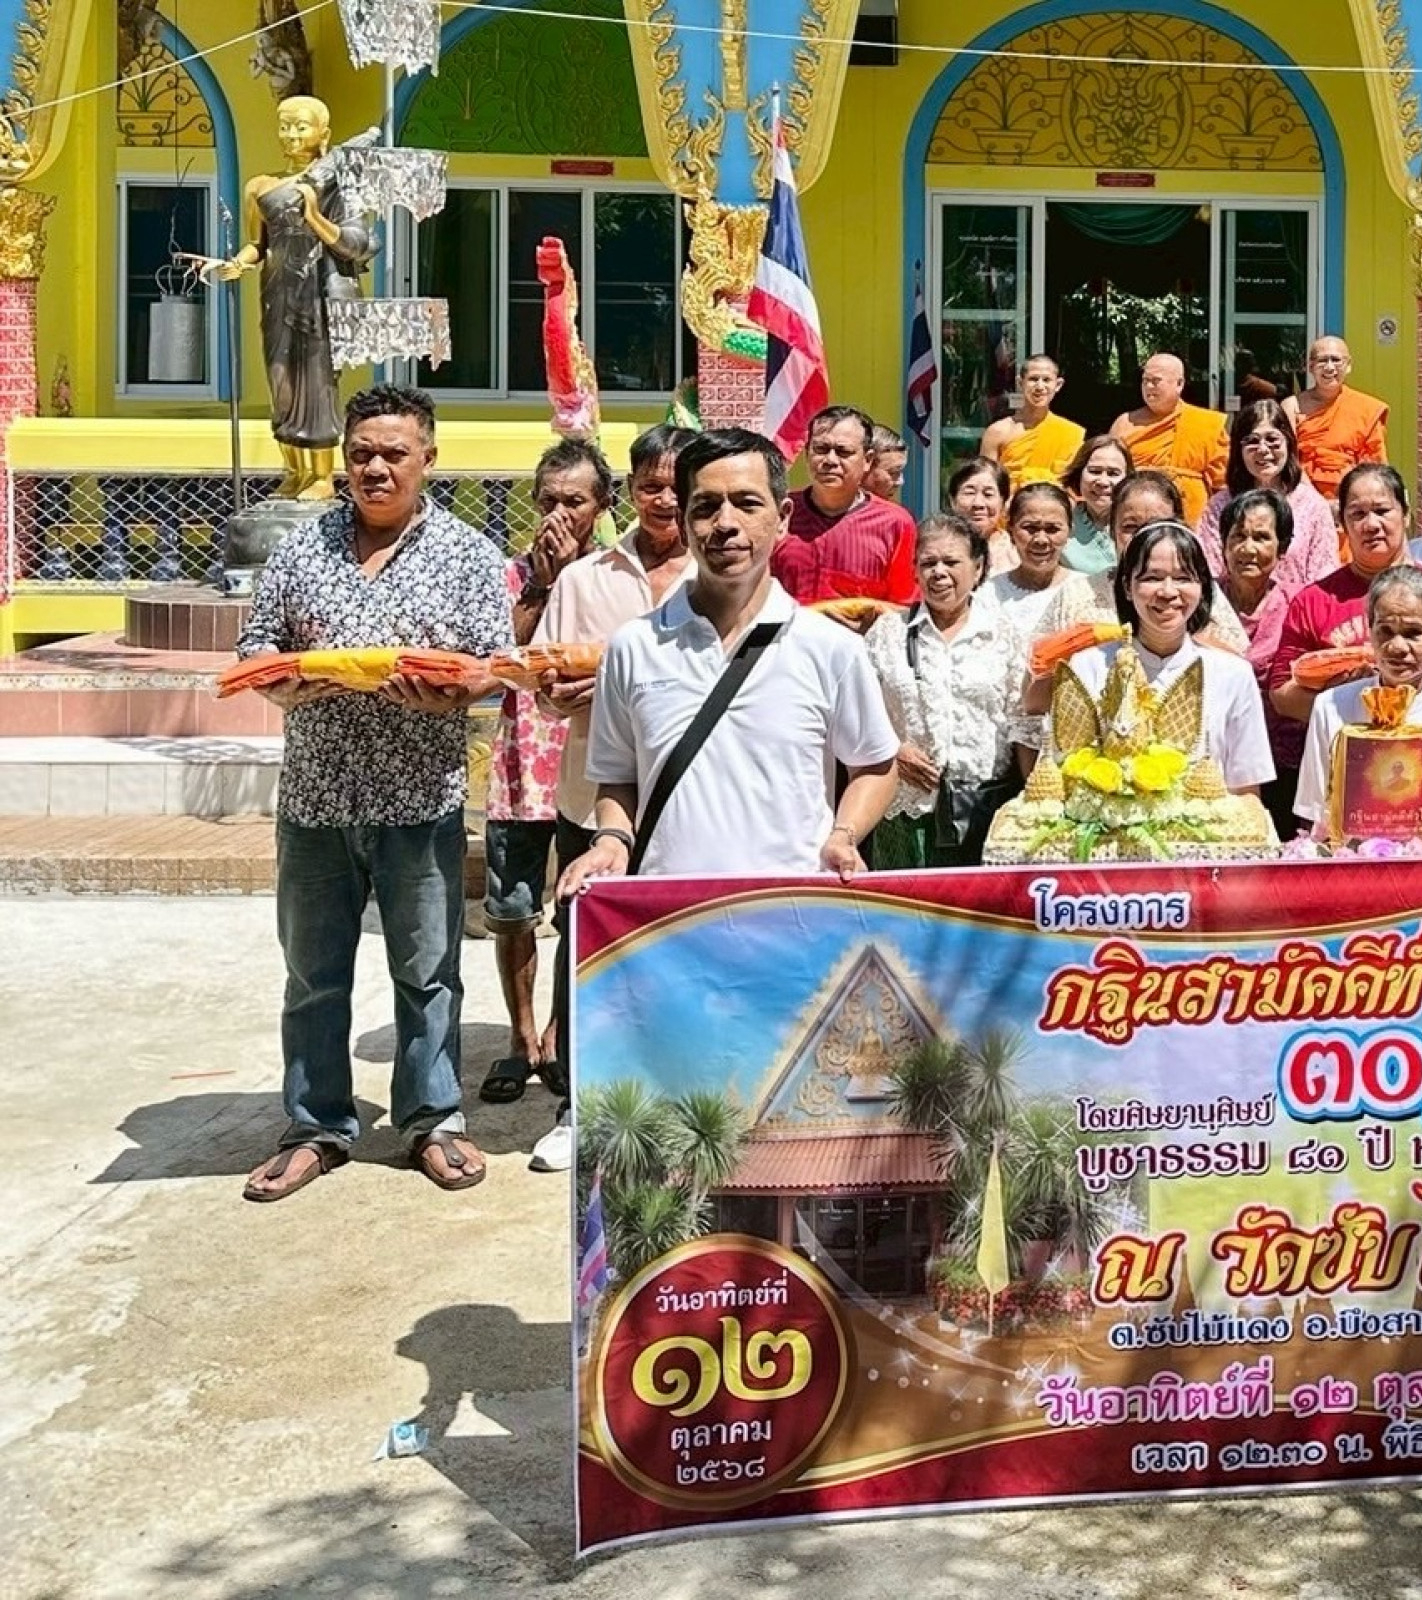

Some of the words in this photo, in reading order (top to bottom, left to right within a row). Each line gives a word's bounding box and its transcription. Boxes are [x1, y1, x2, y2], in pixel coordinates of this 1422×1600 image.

[1032, 881, 1188, 929] โครงการ
[1077, 1093, 1275, 1134] โดยศิษยานุศิษย์
[1080, 1141, 1267, 1189] บูชาธรรม
[1288, 1140, 1344, 1170] ๘๑
[1358, 1126, 1391, 1165] ปี
[1096, 1233, 1186, 1303] ณ
[655, 1269, 788, 1313] วันอาทิตย์ที่
[1112, 1308, 1289, 1345] ต.ซับไม้แดง
[631, 1316, 812, 1417] ๑๒
[1039, 1359, 1270, 1424] วันอาทิตย์ที่
[1293, 1379, 1354, 1413] ๑๒
[671, 1420, 771, 1460] ตุลาคม
[1134, 1444, 1206, 1471] เวลา
[1222, 1441, 1324, 1466] ๑๒.๓๐
[1339, 1436, 1370, 1459] น.
[676, 1457, 766, 1485] ๒๕๖๘
